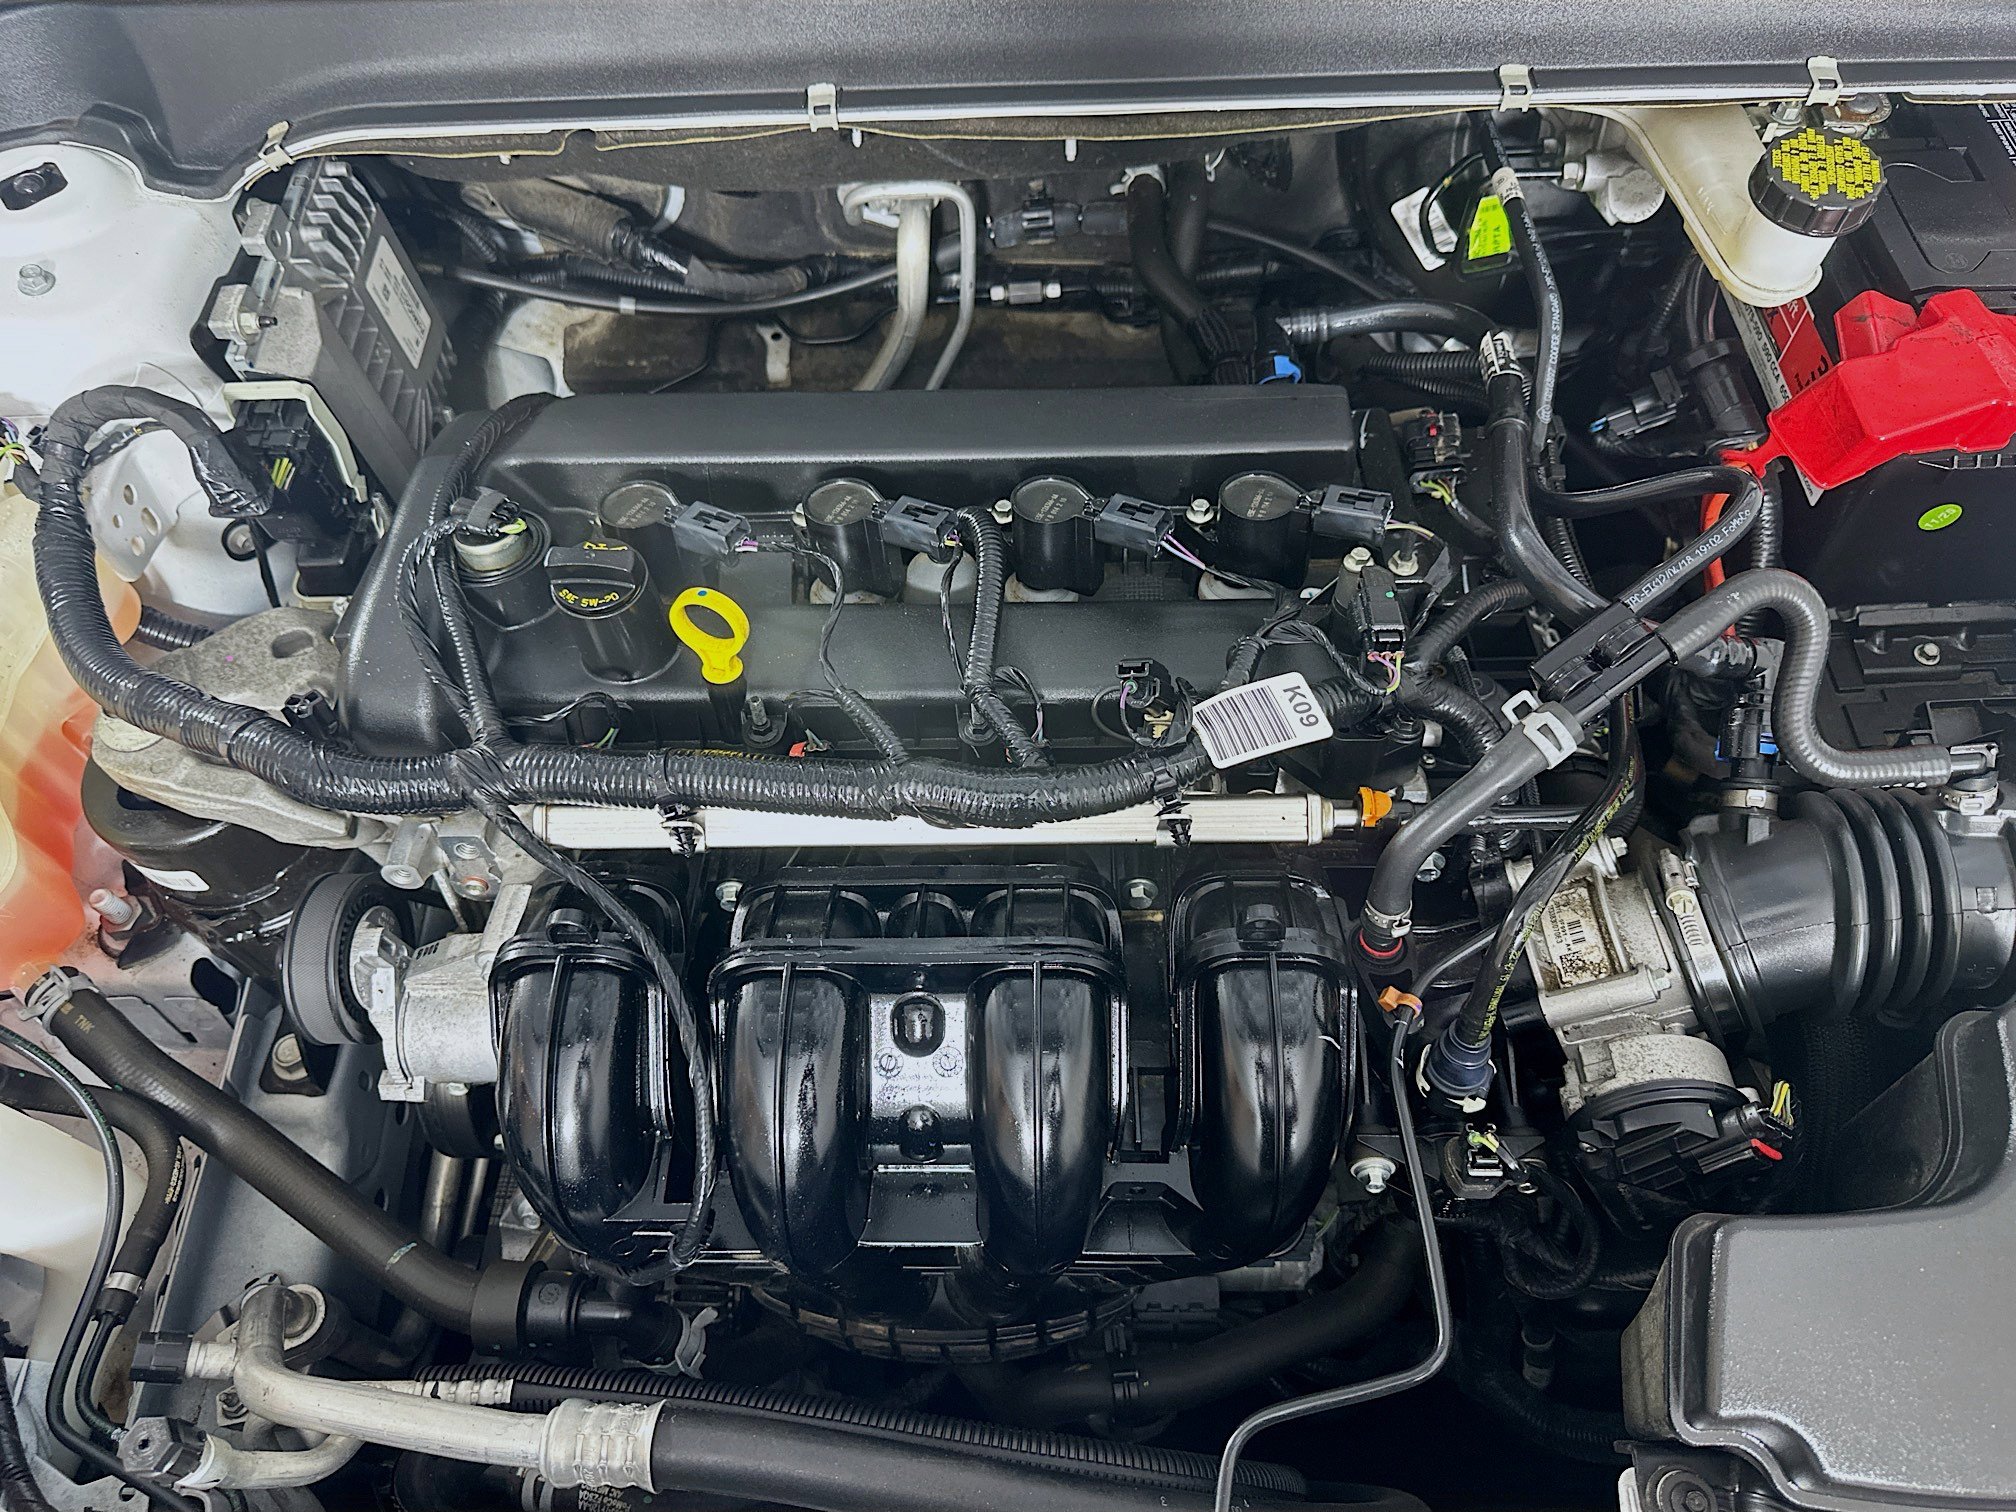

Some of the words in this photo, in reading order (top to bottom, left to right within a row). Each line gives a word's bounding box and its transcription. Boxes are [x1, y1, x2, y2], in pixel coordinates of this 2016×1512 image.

[1549, 292, 1561, 331] STANDARD
[1549, 333, 1560, 364] COOPER
[1769, 361, 1781, 382] CCA
[1695, 534, 1724, 558] 19:02
[1721, 509, 1751, 538] FoMoCo
[559, 588, 579, 604] SAE
[1282, 685, 1319, 727] K09
